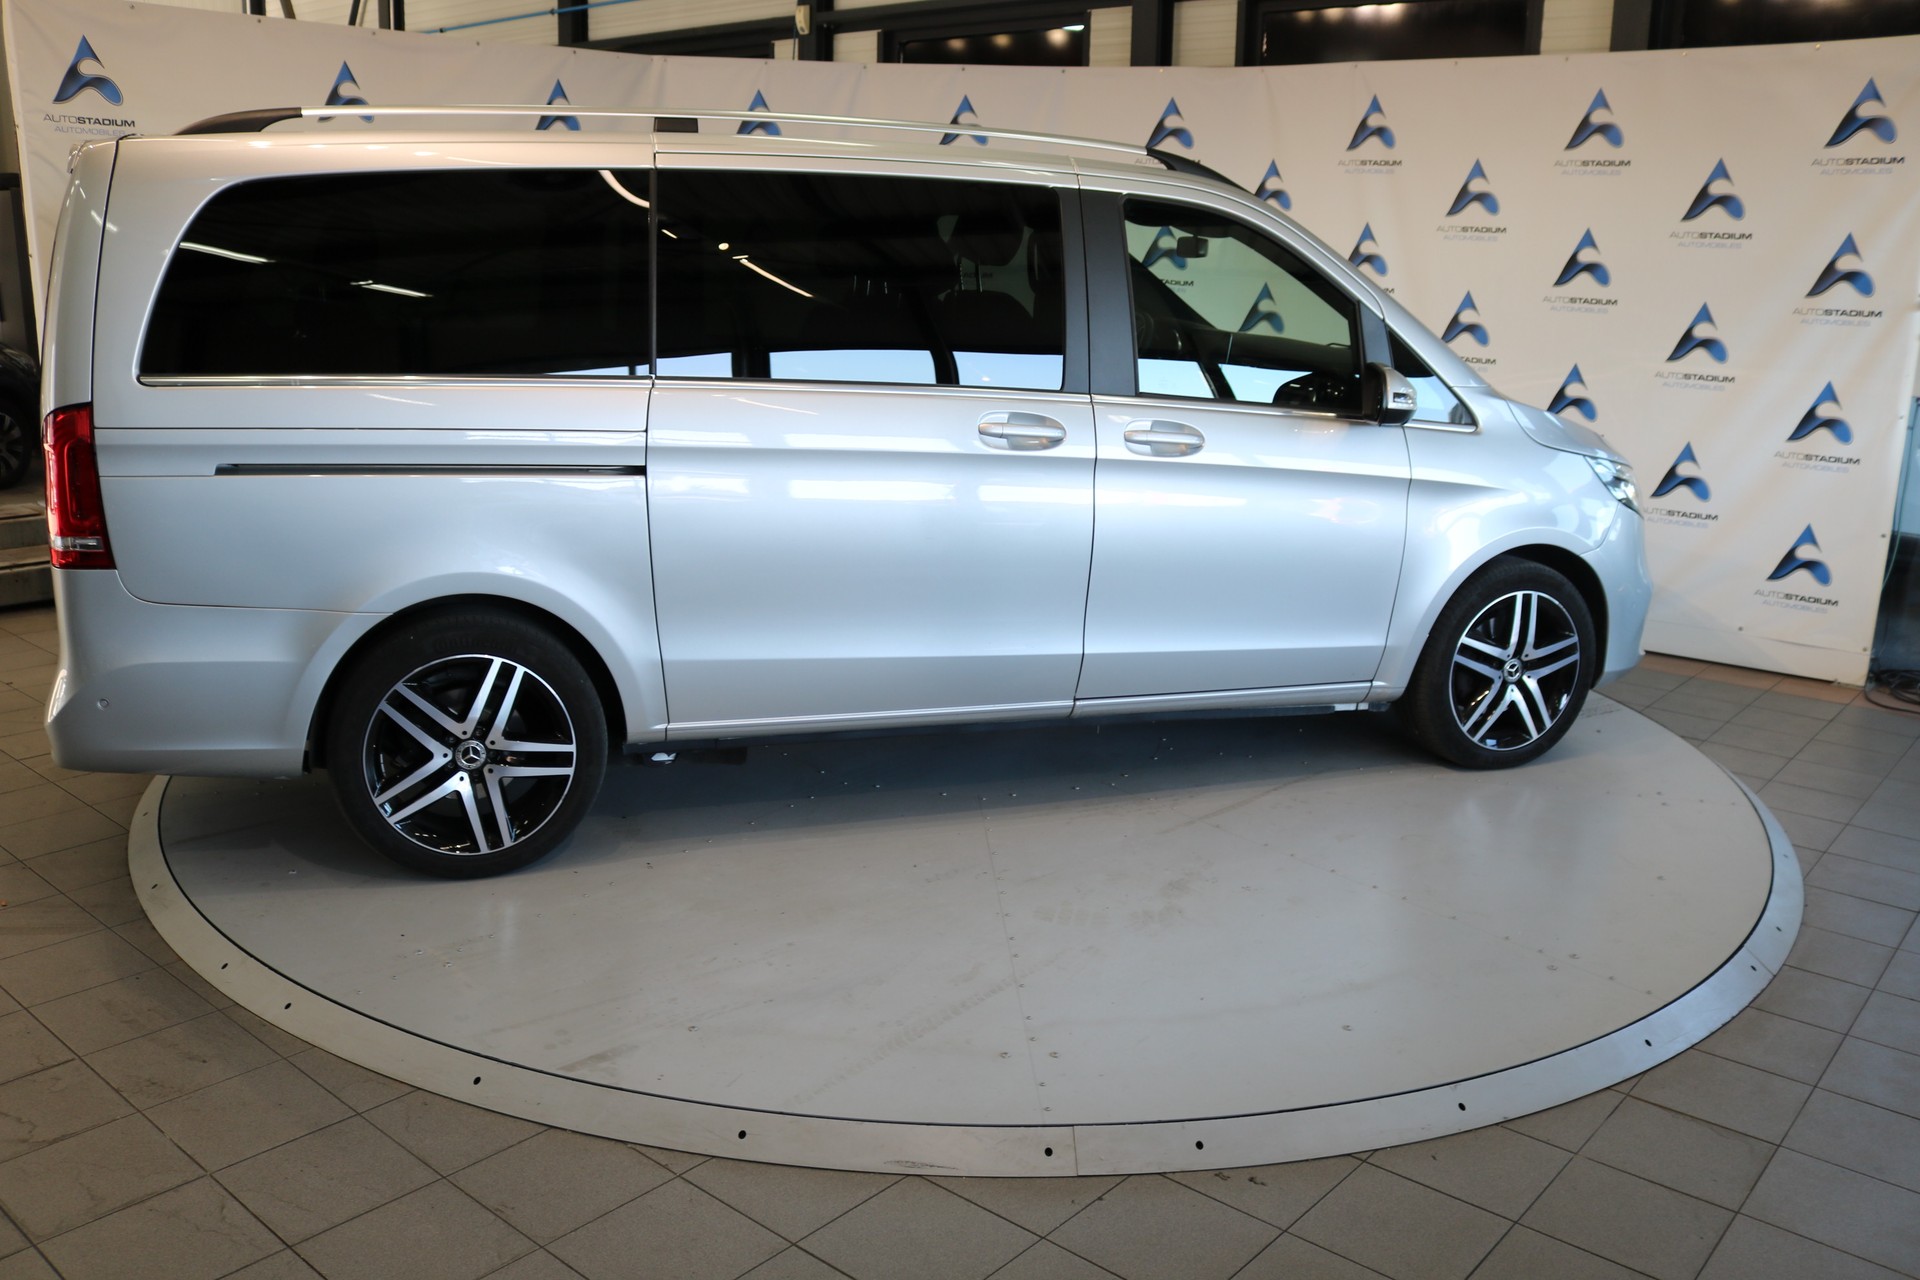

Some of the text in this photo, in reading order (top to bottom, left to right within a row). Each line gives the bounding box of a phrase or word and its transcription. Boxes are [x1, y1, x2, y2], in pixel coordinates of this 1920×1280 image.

[43, 113, 136, 128] AUTOSTADIUM
[1337, 159, 1403, 167] AUTOSTADIUM
[1552, 159, 1632, 168] AUTOSTADIUM
[1811, 156, 1906, 167] AUTOSTADIUM
[1436, 225, 1508, 234] AUTOSTADIUM
[1668, 230, 1753, 241] AUTOSTADIUM
[1542, 295, 1618, 306] AUTOSTADIUM
[1791, 307, 1883, 319] AUTOSTADIUM
[1654, 371, 1736, 384] AUTOSTADIUM
[1773, 450, 1861, 466] AUTOSTADIUM
[1753, 588, 1839, 607] AUTOSTADIUM
